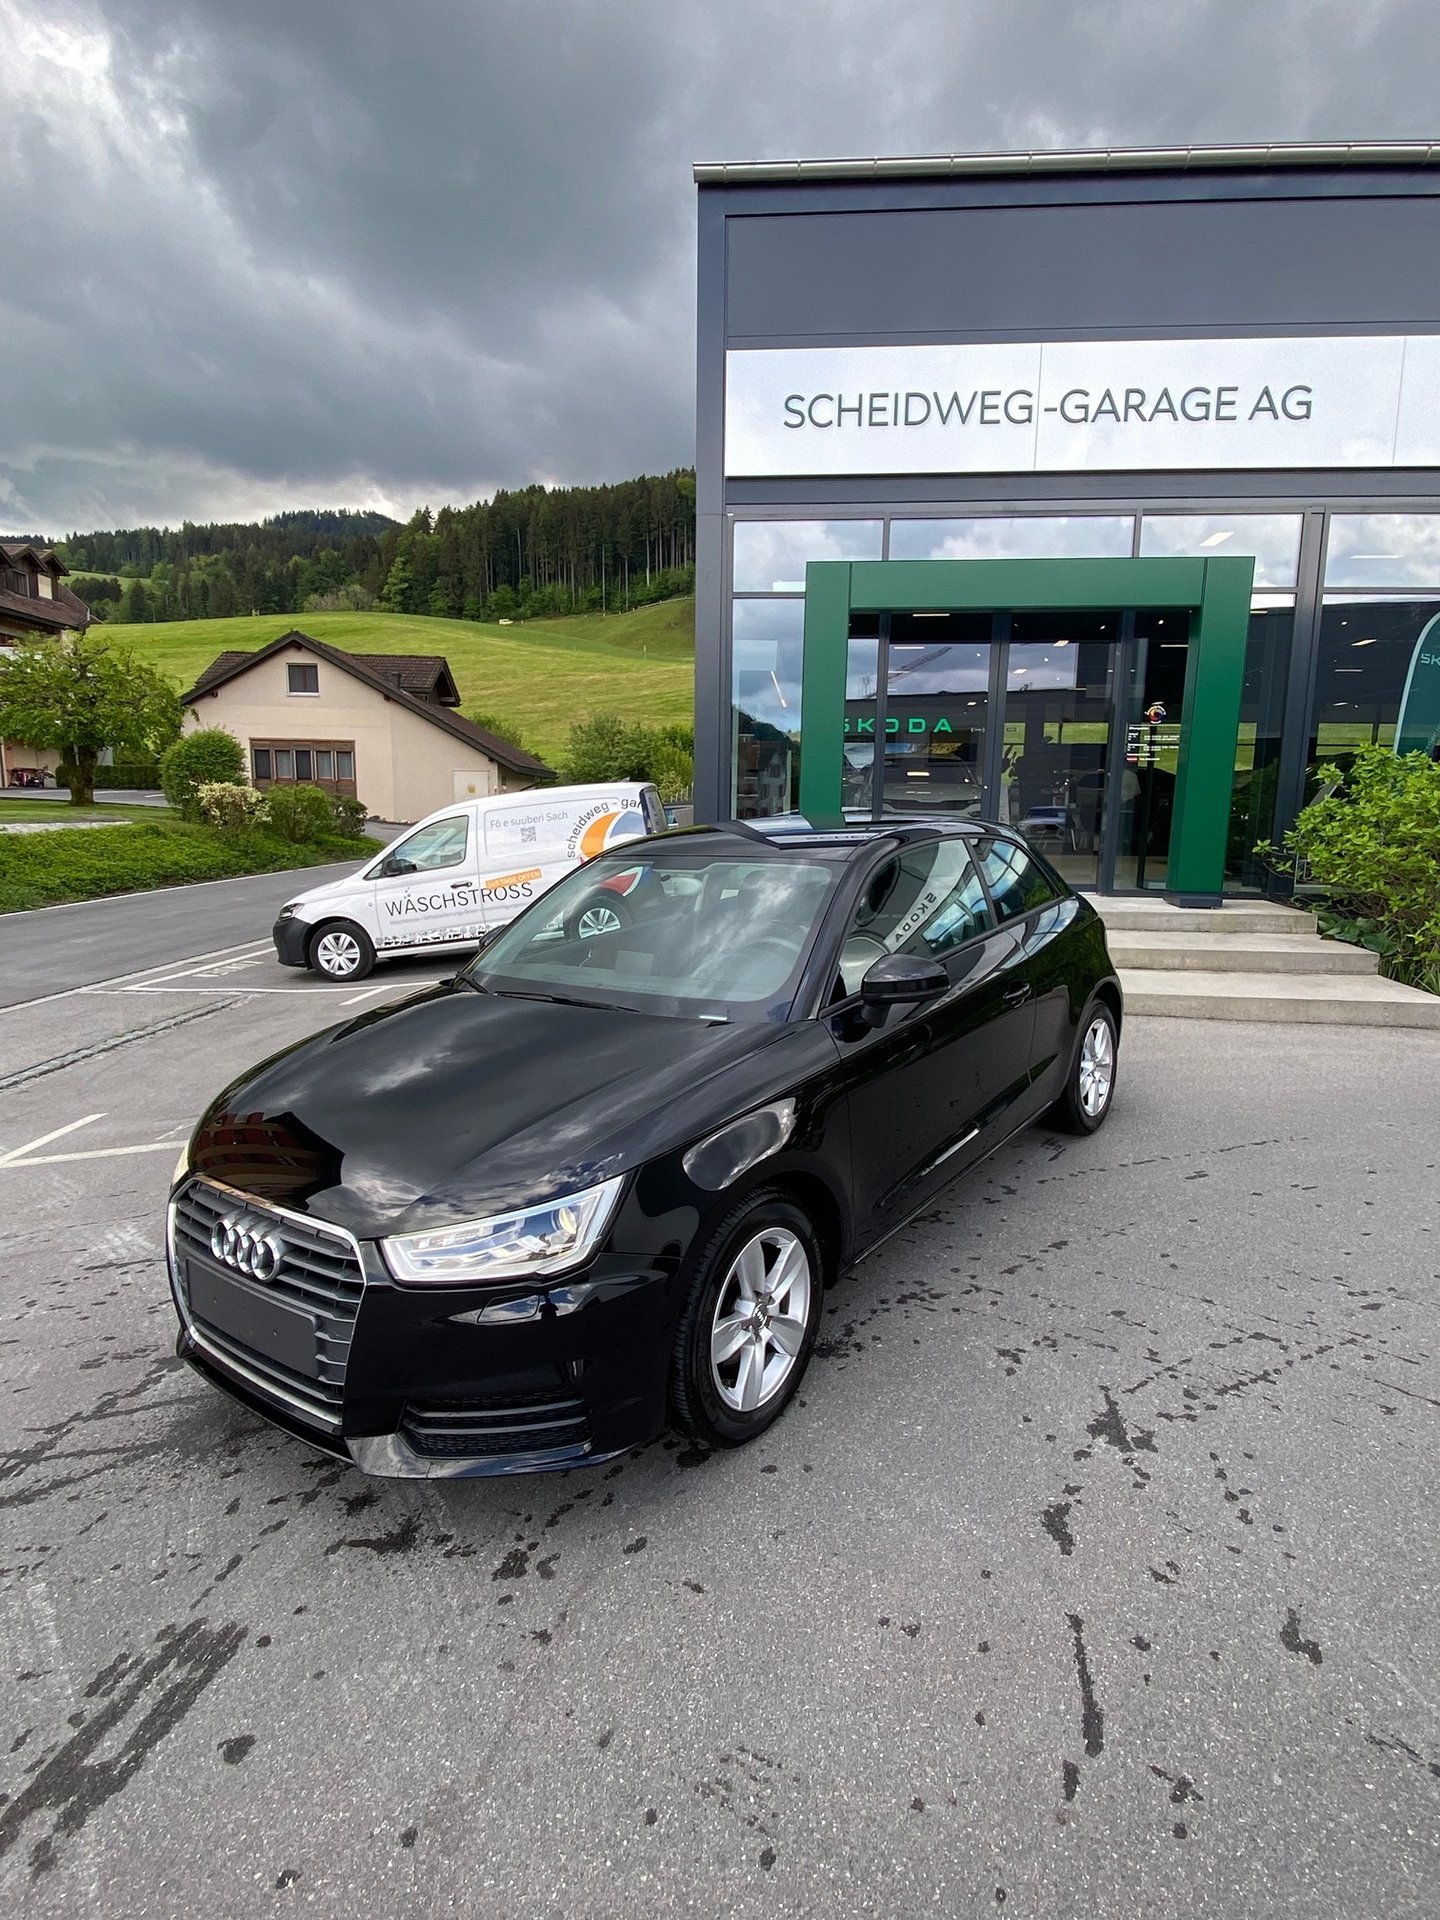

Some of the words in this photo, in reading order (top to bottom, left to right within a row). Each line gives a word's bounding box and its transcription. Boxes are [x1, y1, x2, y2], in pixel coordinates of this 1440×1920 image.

[1248, 384, 1313, 421] AG
[546, 811, 568, 822] Sach
[566, 801, 609, 858] scheidweg
